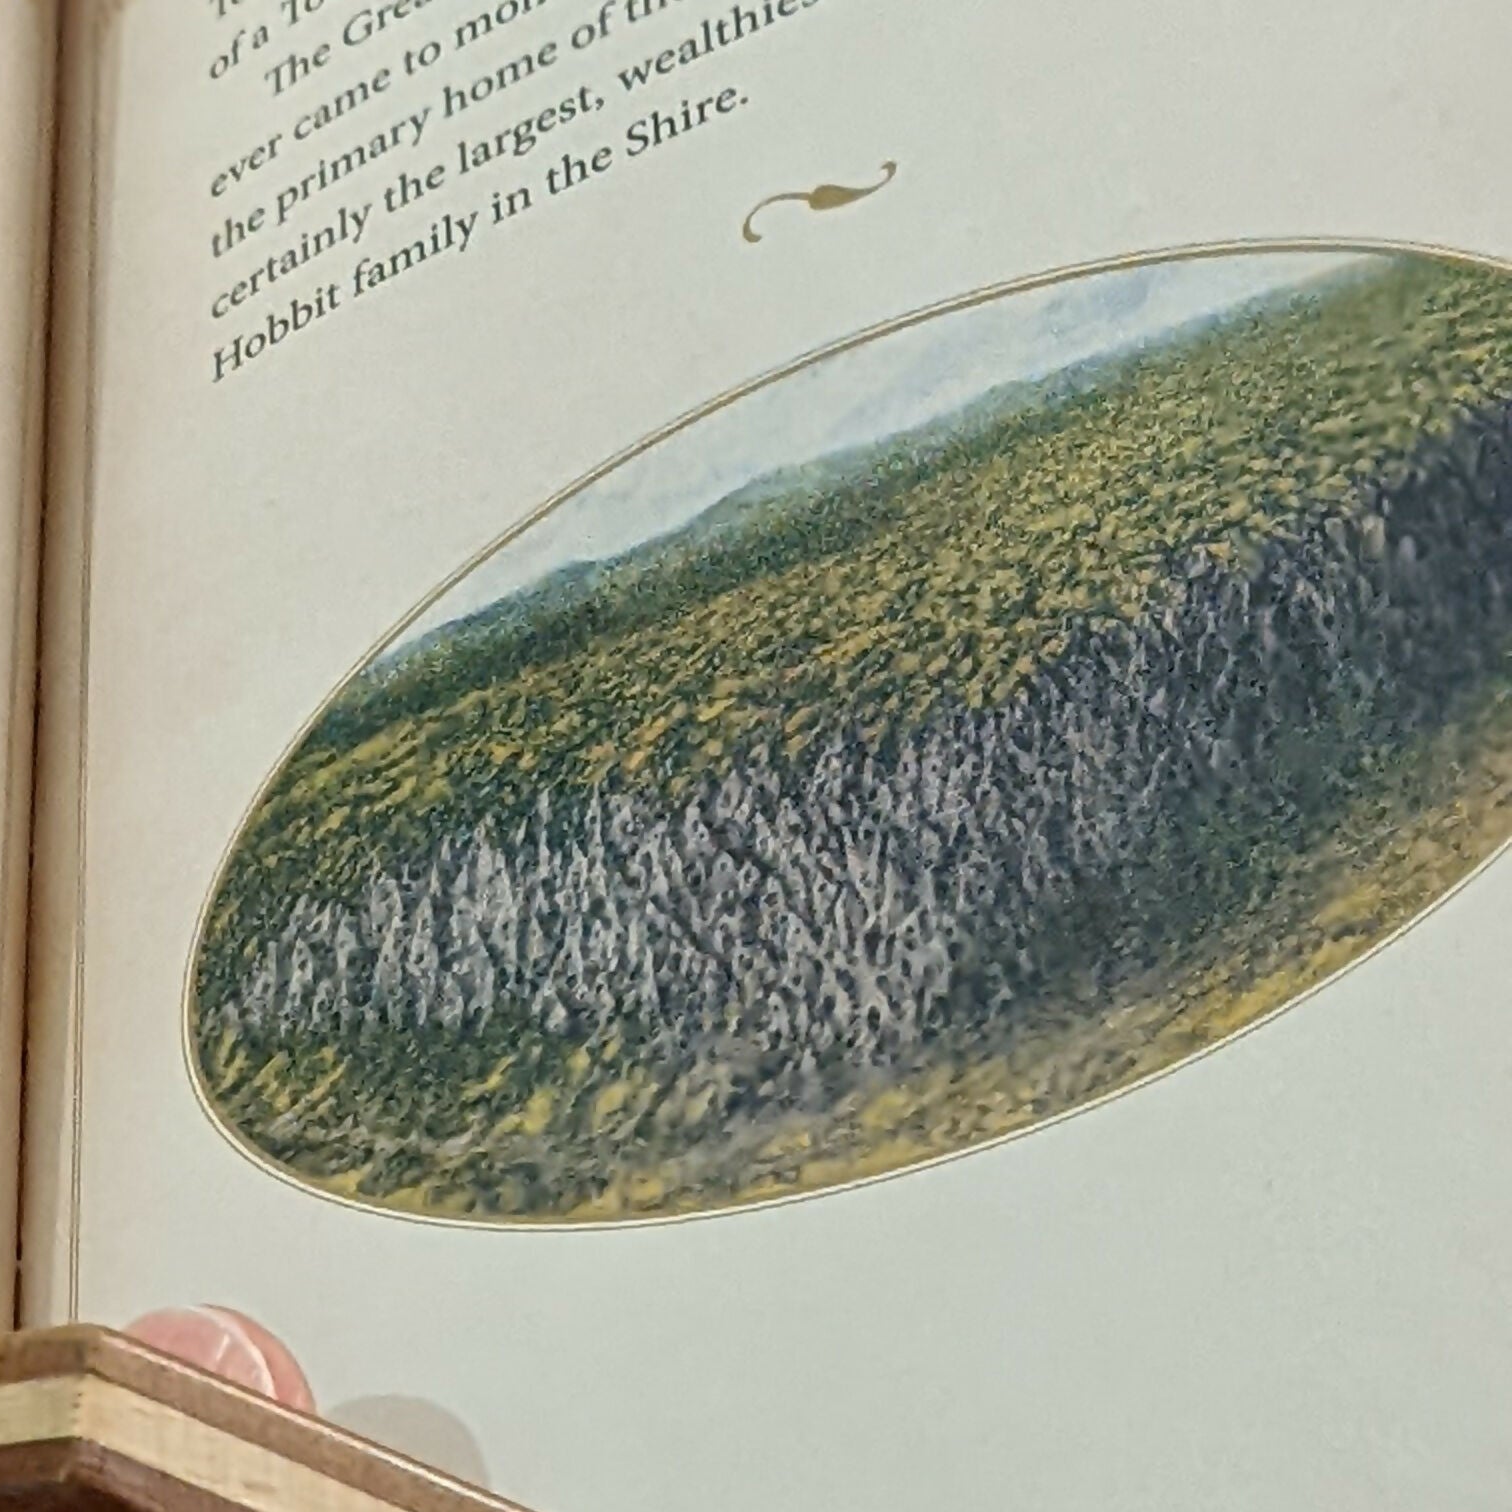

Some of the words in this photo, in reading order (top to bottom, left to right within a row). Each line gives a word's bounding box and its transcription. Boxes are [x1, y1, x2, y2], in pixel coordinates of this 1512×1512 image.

[211, 133, 283, 197] ever
[294, 68, 390, 140] came
[404, 41, 441, 76] to
[212, 208, 265, 258] the
[277, 106, 432, 226] primary
[443, 42, 557, 118] home
[571, 0, 616, 49] of
[264, 43, 330, 96] The
[212, 203, 372, 319] certainly
[384, 165, 445, 213] the
[458, 86, 604, 175] largest,
[212, 284, 340, 383] Hobbit
[353, 211, 479, 297] family
[492, 188, 532, 225] in
[546, 147, 612, 195] the
[626, 88, 748, 157] Shire.
